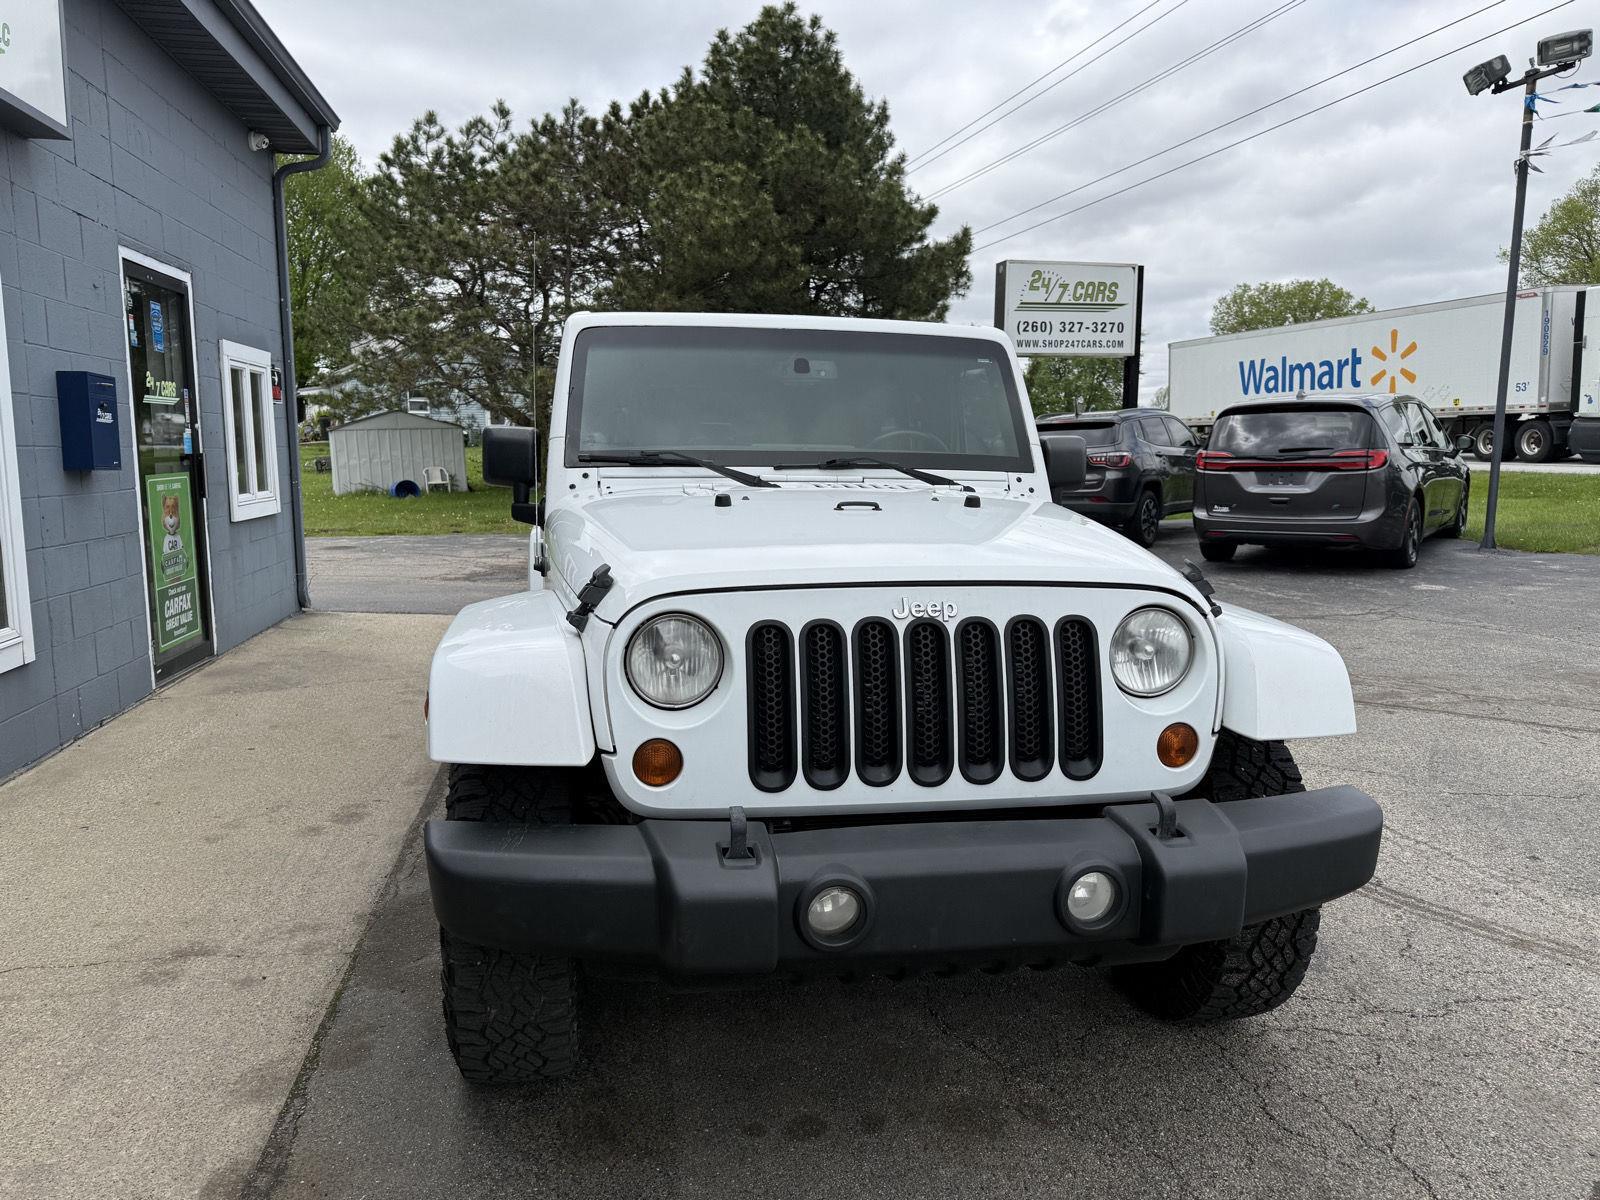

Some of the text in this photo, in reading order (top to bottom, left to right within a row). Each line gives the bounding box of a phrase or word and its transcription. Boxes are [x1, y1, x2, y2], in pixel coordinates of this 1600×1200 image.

[1072, 281, 1119, 303] CARS
[1016, 321, 1124, 335] (260) 327-3270
[1542, 310, 1550, 356] 190629
[1016, 339, 1124, 349] WWW.SHOP247CARS.COM
[1239, 347, 1362, 395] Walmart
[161, 380, 177, 397] CARS
[165, 593, 191, 618] CARFAX
[892, 597, 958, 622] Jeep
[166, 615, 180, 632] GREAT
[180, 610, 193, 625] VALUE
